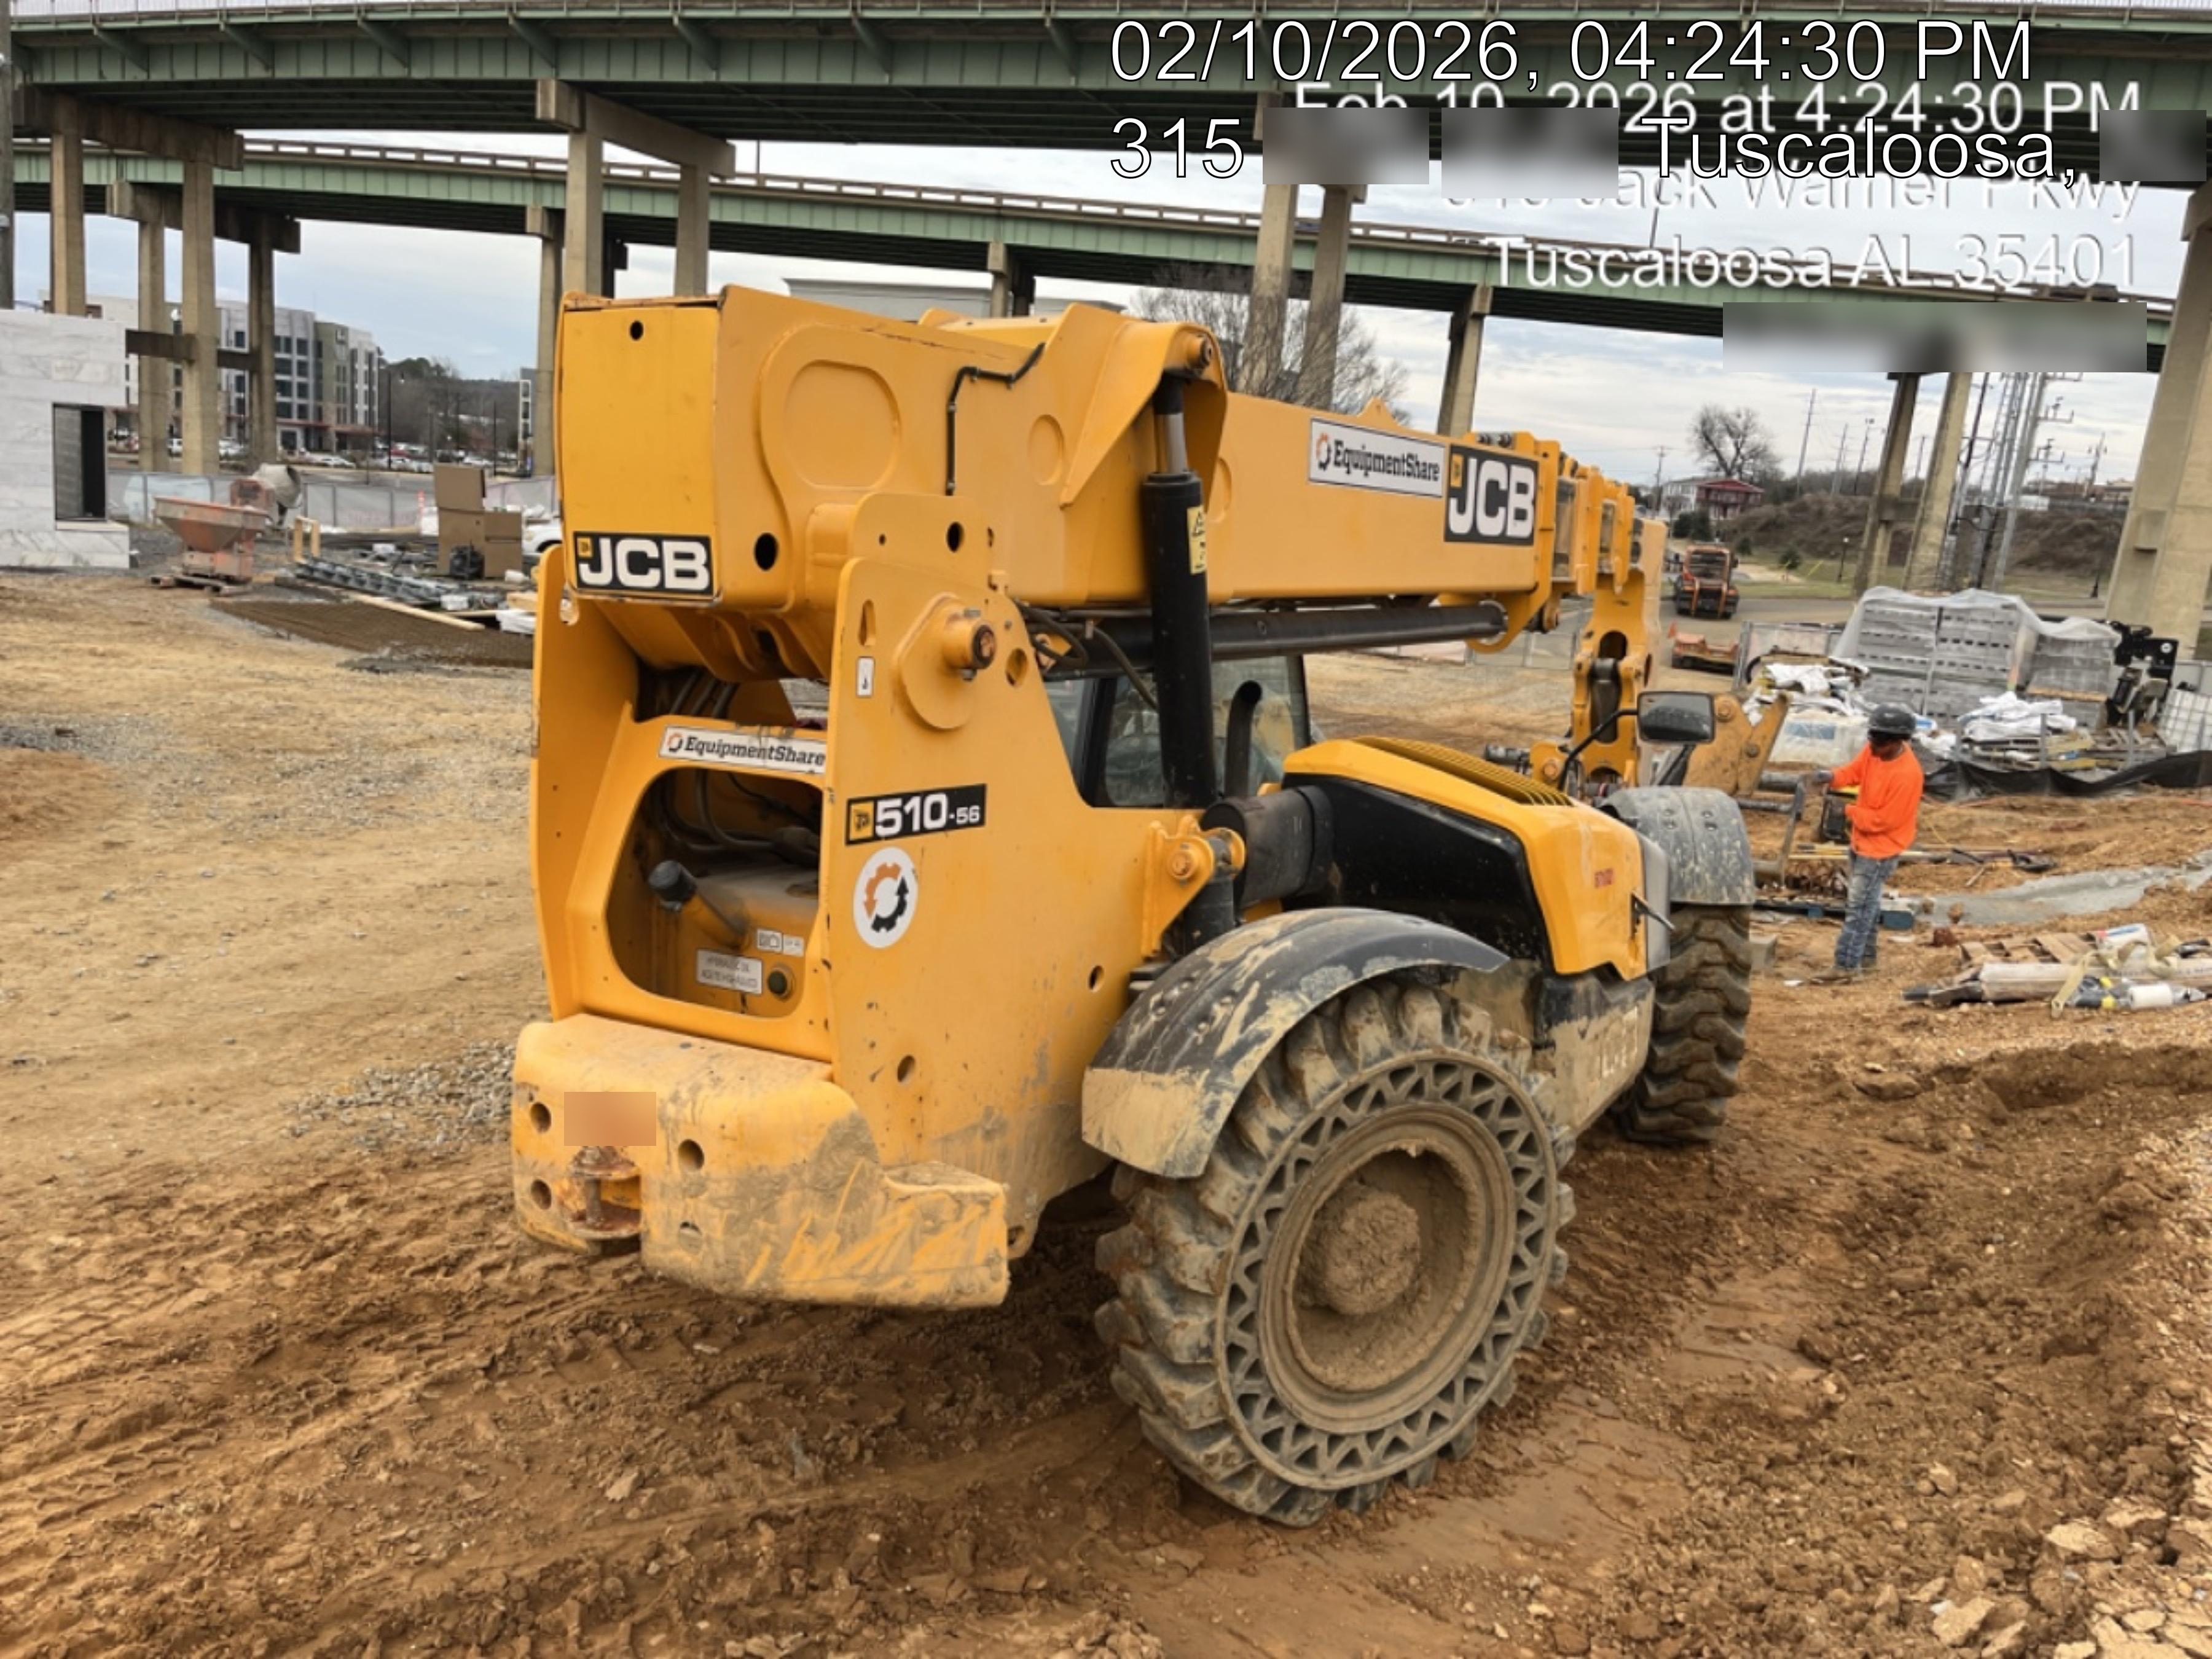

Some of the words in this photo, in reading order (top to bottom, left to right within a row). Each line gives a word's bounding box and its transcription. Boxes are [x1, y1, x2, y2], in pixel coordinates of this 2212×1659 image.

[1333, 440, 1440, 482] EquipmentShare
[1448, 456, 1535, 538] JCB
[578, 537, 710, 590] JCB
[685, 737, 826, 766] EquipmentShare
